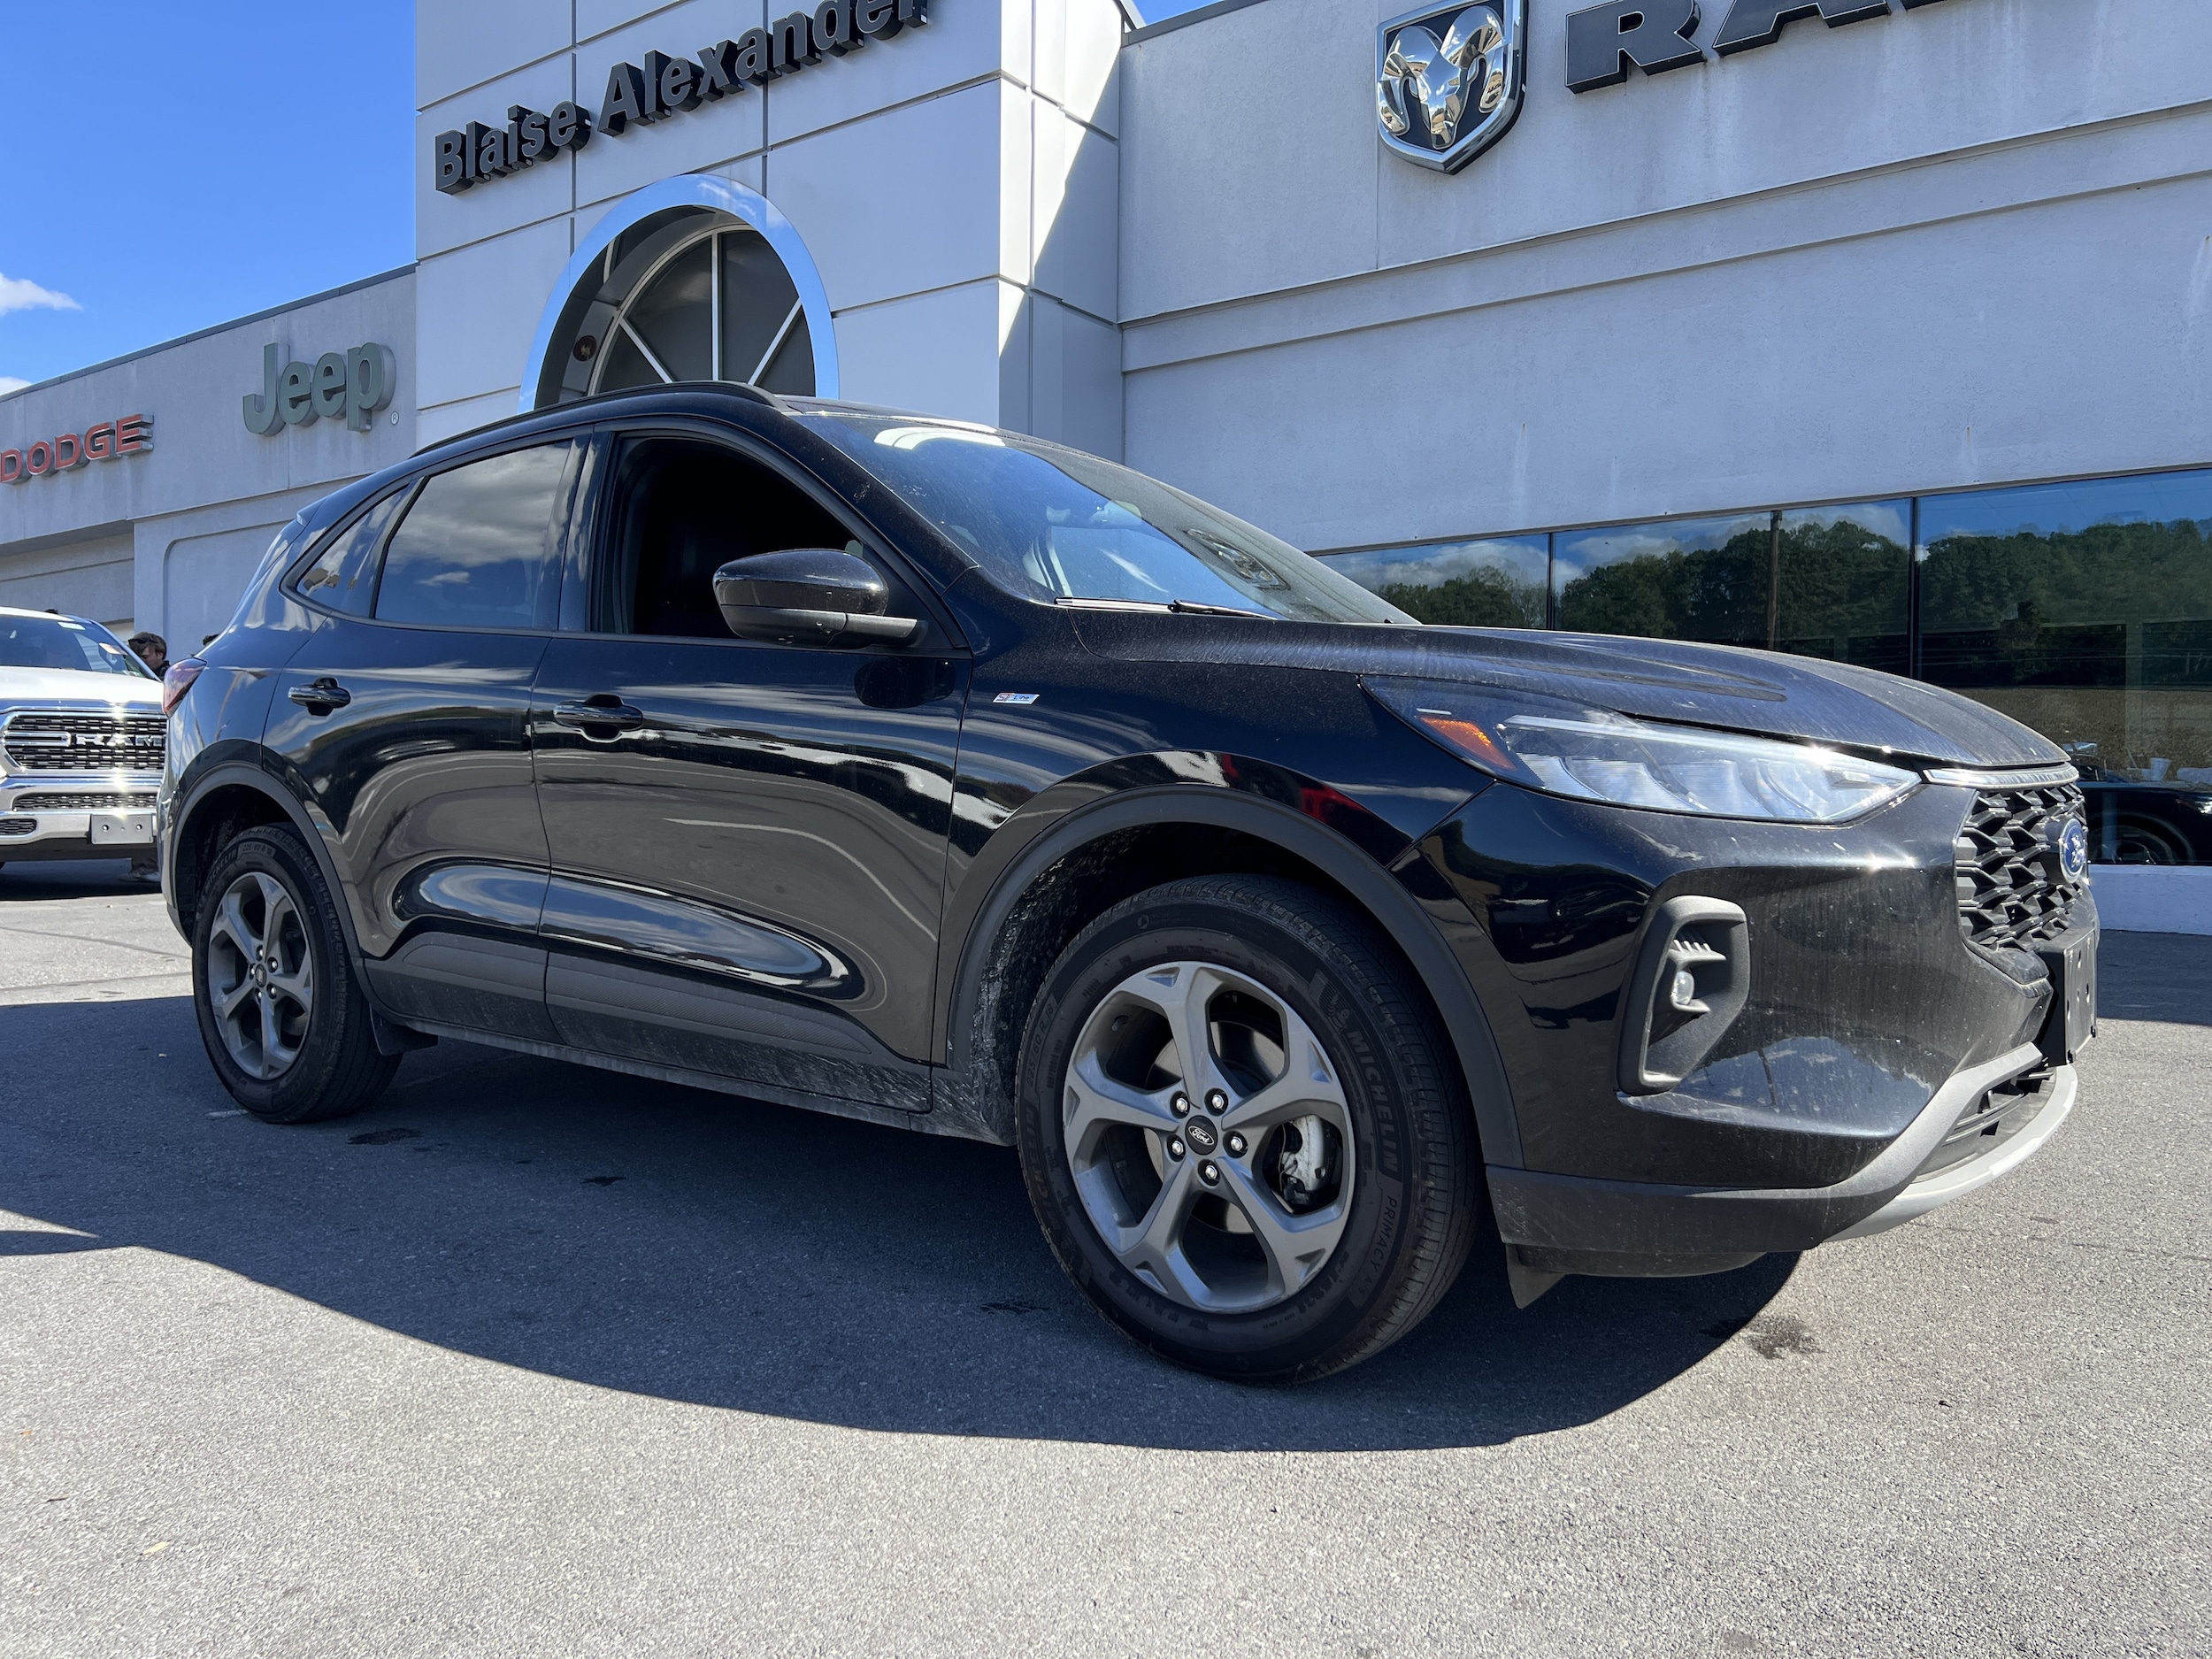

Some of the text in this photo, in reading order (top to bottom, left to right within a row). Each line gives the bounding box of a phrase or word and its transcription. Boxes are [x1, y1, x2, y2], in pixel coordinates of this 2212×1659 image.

[434, 101, 588, 194] Blaise
[242, 342, 395, 436] Jeep
[0, 413, 151, 484] DODGE
[75, 733, 163, 747] RAM
[1346, 1030, 1399, 1173] MICHELIN
[1370, 1195, 1397, 1272] PRIMACY
